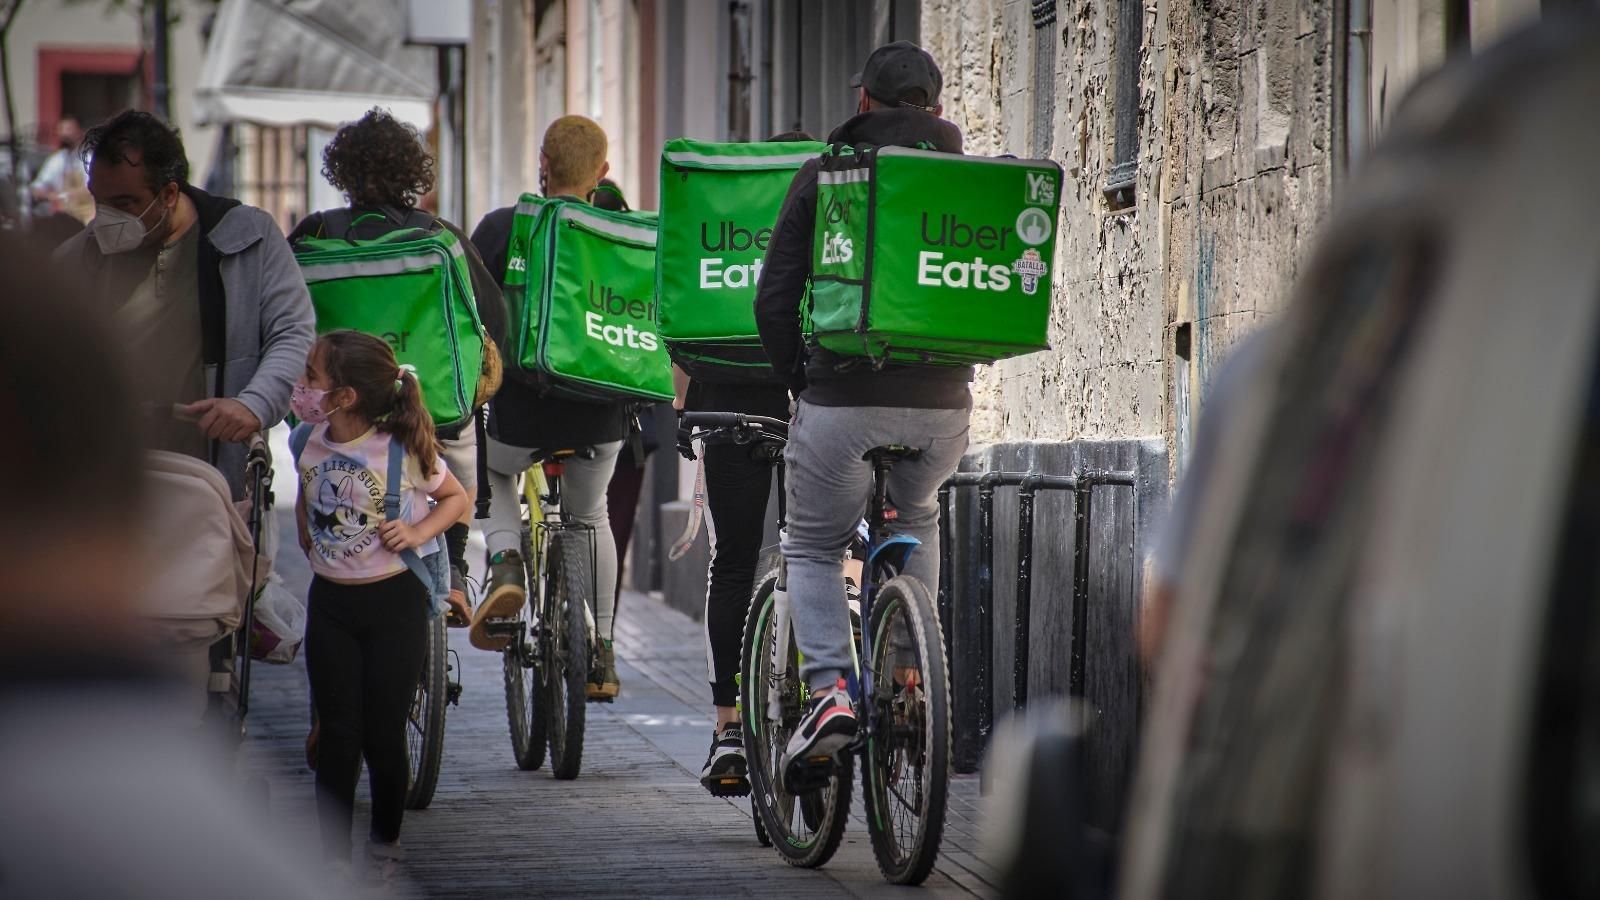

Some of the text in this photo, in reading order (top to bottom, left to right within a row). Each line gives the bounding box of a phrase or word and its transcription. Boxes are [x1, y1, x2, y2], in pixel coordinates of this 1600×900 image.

[701, 221, 773, 252] Ube
[922, 212, 1011, 250] Uber
[700, 258, 763, 288] Eat
[918, 251, 1011, 291] Eats
[1017, 260, 1044, 271] BATALLA
[590, 280, 654, 321] Uber
[381, 331, 410, 352] er
[586, 311, 658, 351] Eats
[322, 460, 357, 475] LIKE
[343, 525, 380, 559] MOUS
